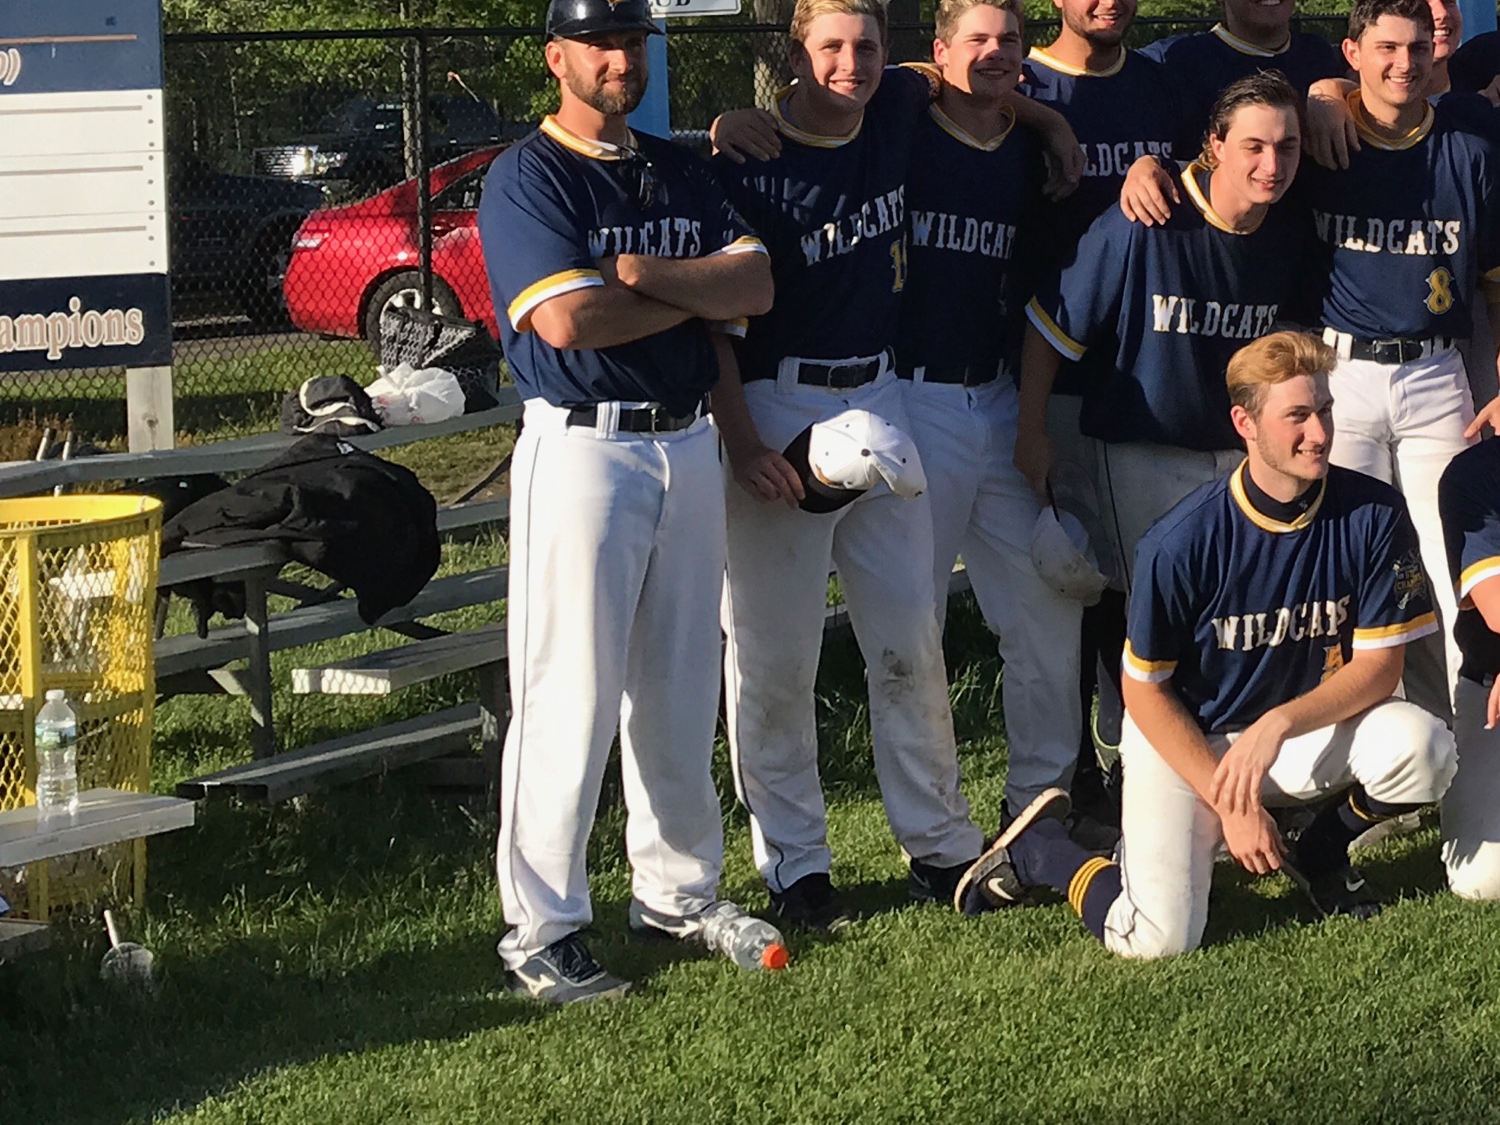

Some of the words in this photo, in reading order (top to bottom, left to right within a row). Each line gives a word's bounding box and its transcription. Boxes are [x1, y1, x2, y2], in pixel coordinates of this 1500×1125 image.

[1312, 208, 1461, 255] WILDCATS
[1423, 266, 1455, 315] 8
[1152, 294, 1278, 339] WILDCATS
